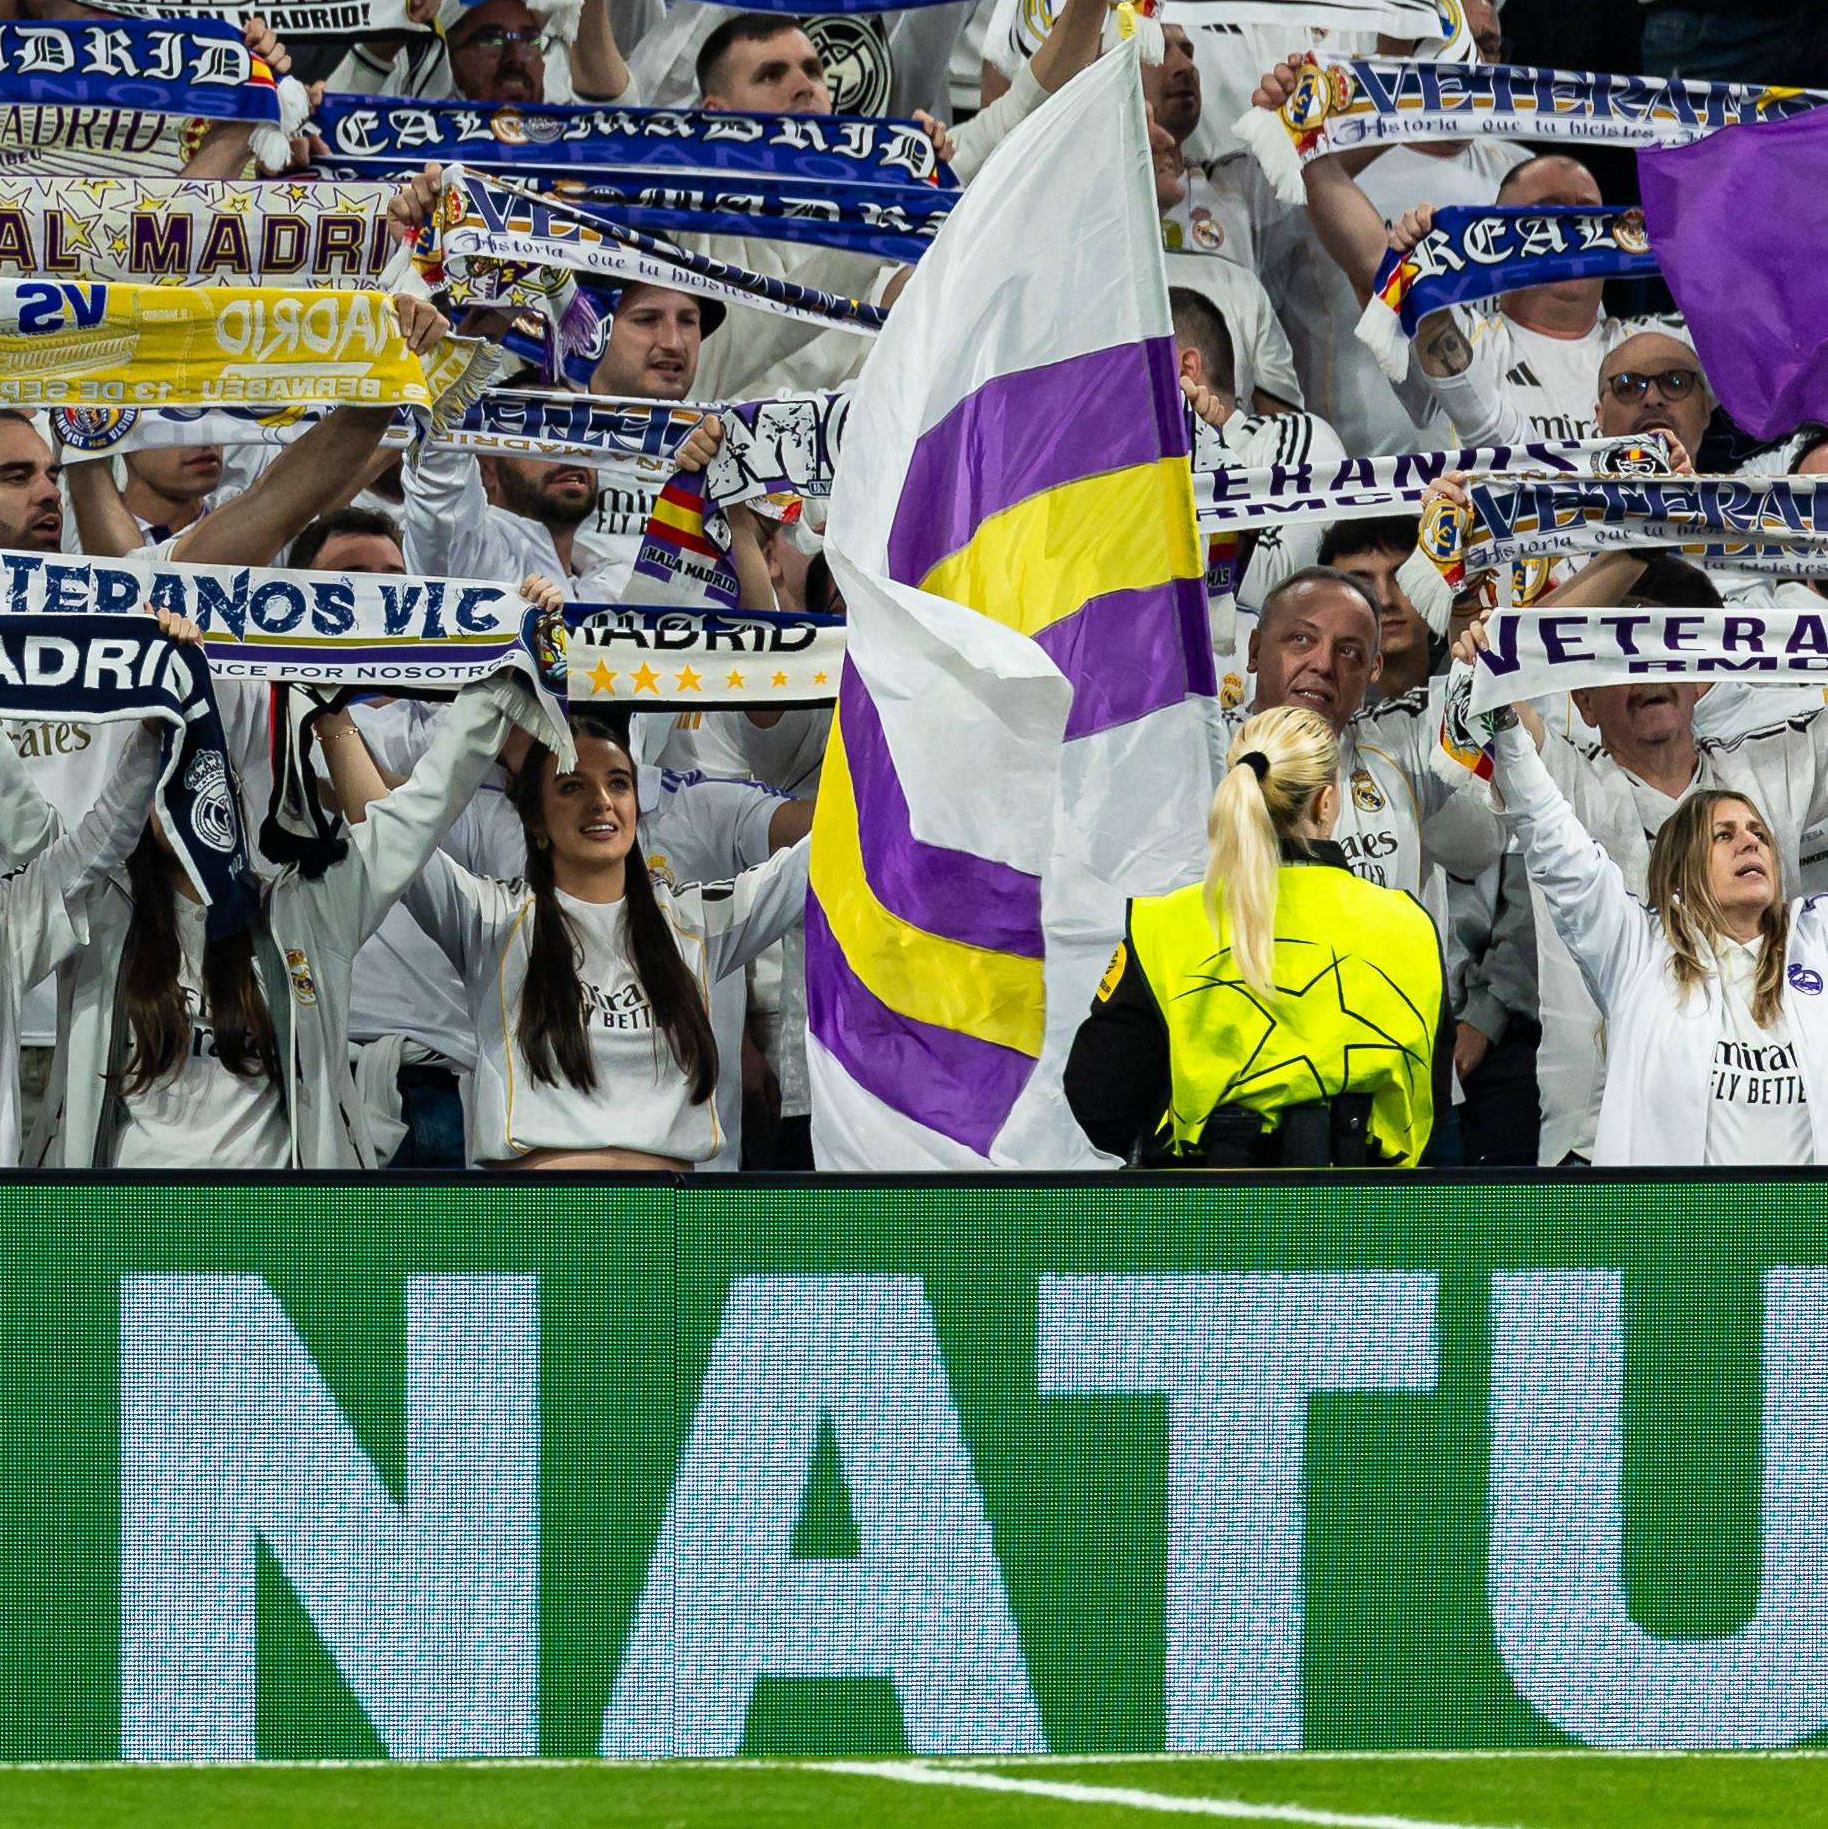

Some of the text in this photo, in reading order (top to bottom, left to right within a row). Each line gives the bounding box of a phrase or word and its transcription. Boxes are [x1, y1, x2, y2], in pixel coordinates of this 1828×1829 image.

[560, 110, 937, 182] MADRID
[1409, 212, 1621, 288] REAL
[288, 664, 338, 681] POR
[118, 1264, 1828, 1760] NATU
